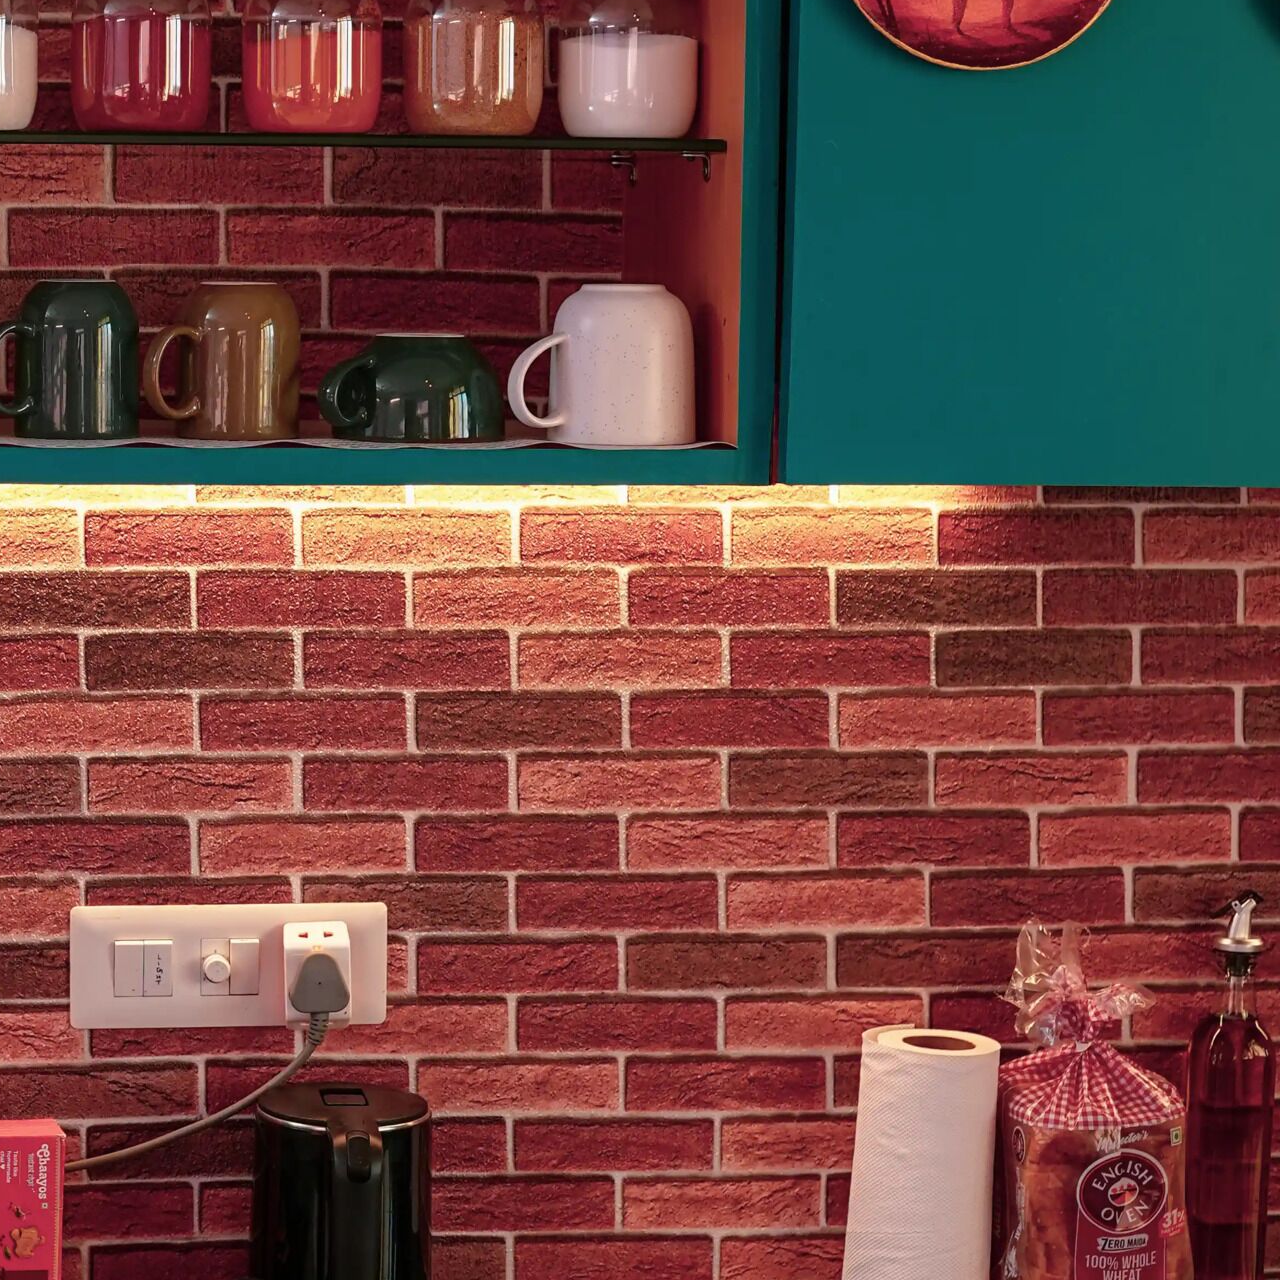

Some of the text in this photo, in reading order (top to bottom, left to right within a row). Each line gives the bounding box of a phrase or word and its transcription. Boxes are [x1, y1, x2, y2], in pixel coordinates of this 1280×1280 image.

[36, 1143, 50, 1200] Chaayos
[1101, 1199, 1150, 1225] OVEN
[1101, 1237, 1125, 1251] ZERO
[1085, 1251, 1157, 1270] 100% WHOLE
